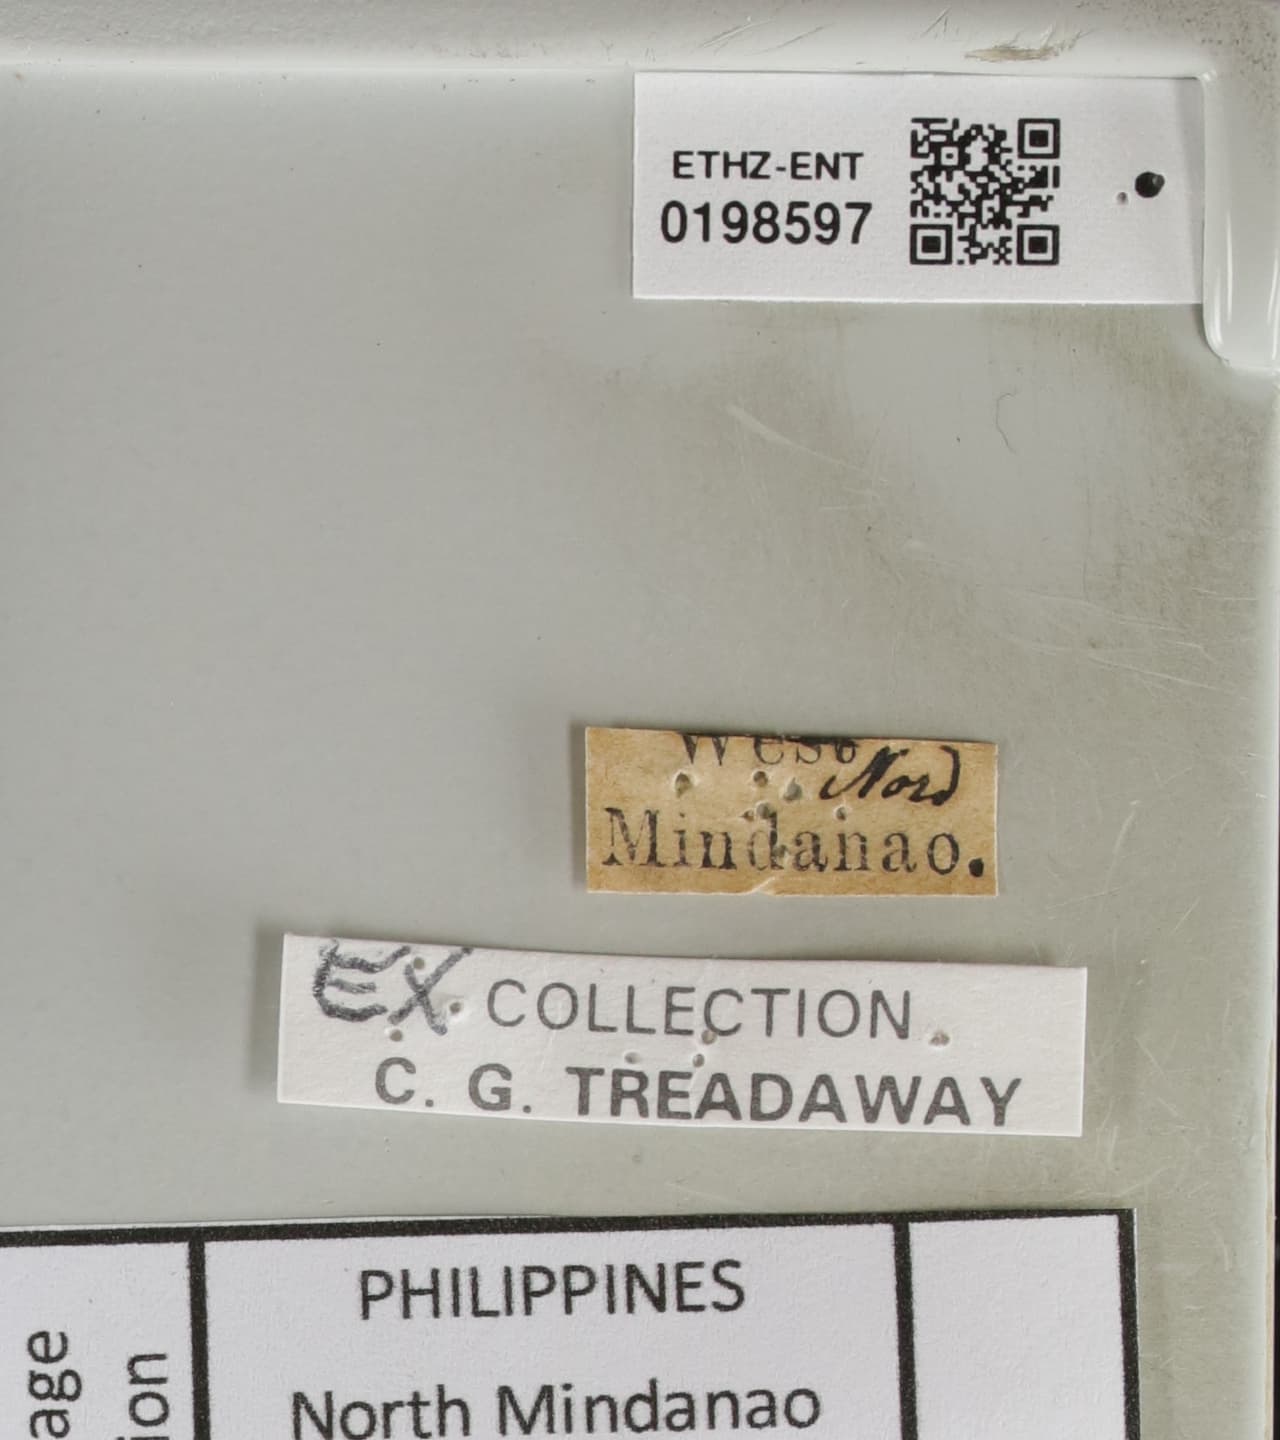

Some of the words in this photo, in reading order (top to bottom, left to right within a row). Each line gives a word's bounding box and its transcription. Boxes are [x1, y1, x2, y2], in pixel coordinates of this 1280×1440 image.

[672, 149, 865, 181] ETHZ-ENT
[660, 199, 873, 246] 0198597
[602, 806, 985, 878] Mindanao.
[487, 978, 911, 1042] COLLECTION
[374, 1056, 434, 1108] C.
[468, 1062, 532, 1114] G.
[564, 1066, 1022, 1127] TREADAWAY
[358, 1258, 746, 1321] PHILIPPINES
[495, 1377, 822, 1438] Mindanao
